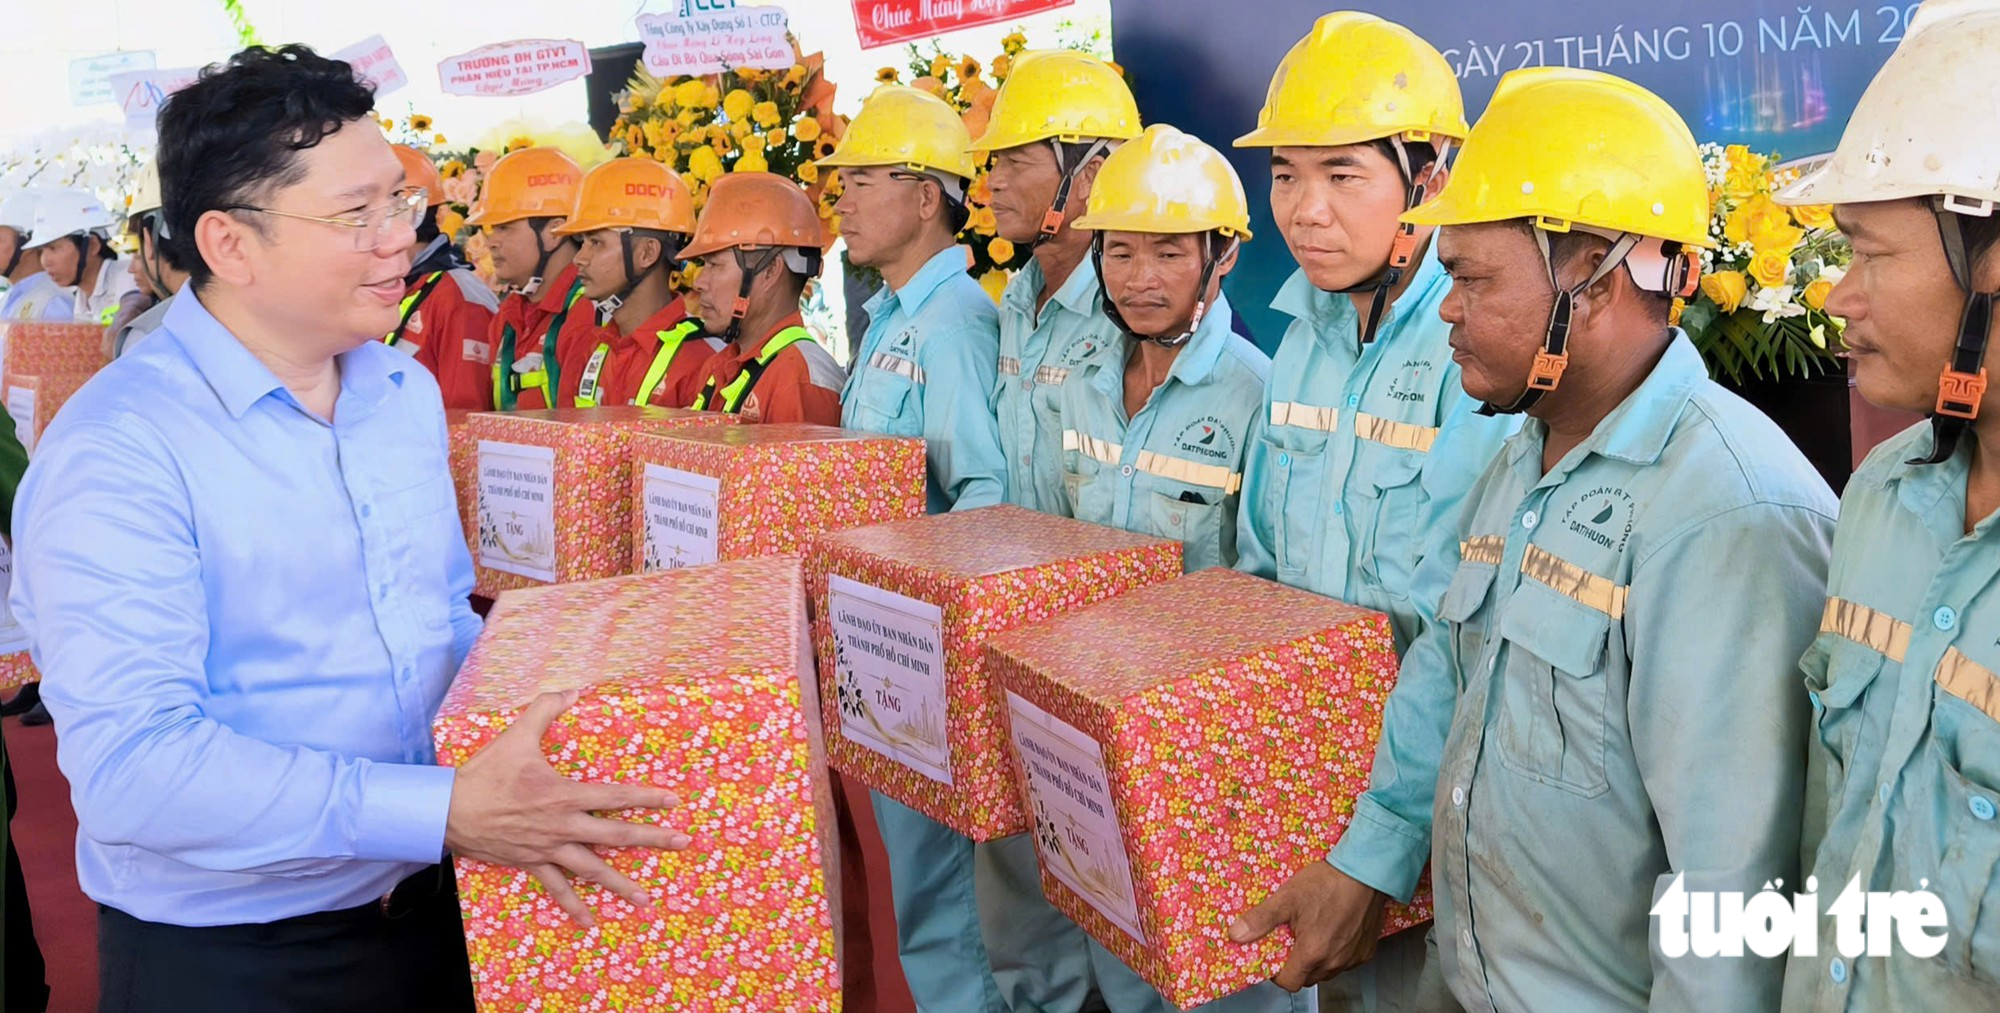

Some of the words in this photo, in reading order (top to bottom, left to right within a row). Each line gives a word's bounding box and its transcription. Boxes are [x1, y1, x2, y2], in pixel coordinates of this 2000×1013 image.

[760, 13, 782, 27] CTCP
[872, 4, 912, 31] Chúc
[536, 46, 567, 60] GTVT
[1443, 40, 1505, 79] GÀY
[1514, 40, 1545, 70] 21
[1554, 24, 1690, 68] THÁNG
[1702, 21, 1744, 57] 10
[1758, 5, 1861, 53] NĂM
[838, 610, 856, 627] LÃNH
[857, 618, 872, 633] ĐẠO
[882, 626, 897, 641] BAN
[897, 632, 918, 649] NHÂN
[918, 637, 934, 654] DÂN
[847, 635, 870, 653] THÀNH
[871, 642, 885, 658] PHỐ
[885, 646, 896, 663] HỒ
[897, 653, 910, 668] CHÍ
[911, 658, 930, 676] MINH
[875, 689, 901, 712] TẶNG
[1065, 826, 1089, 856] TẶNG
